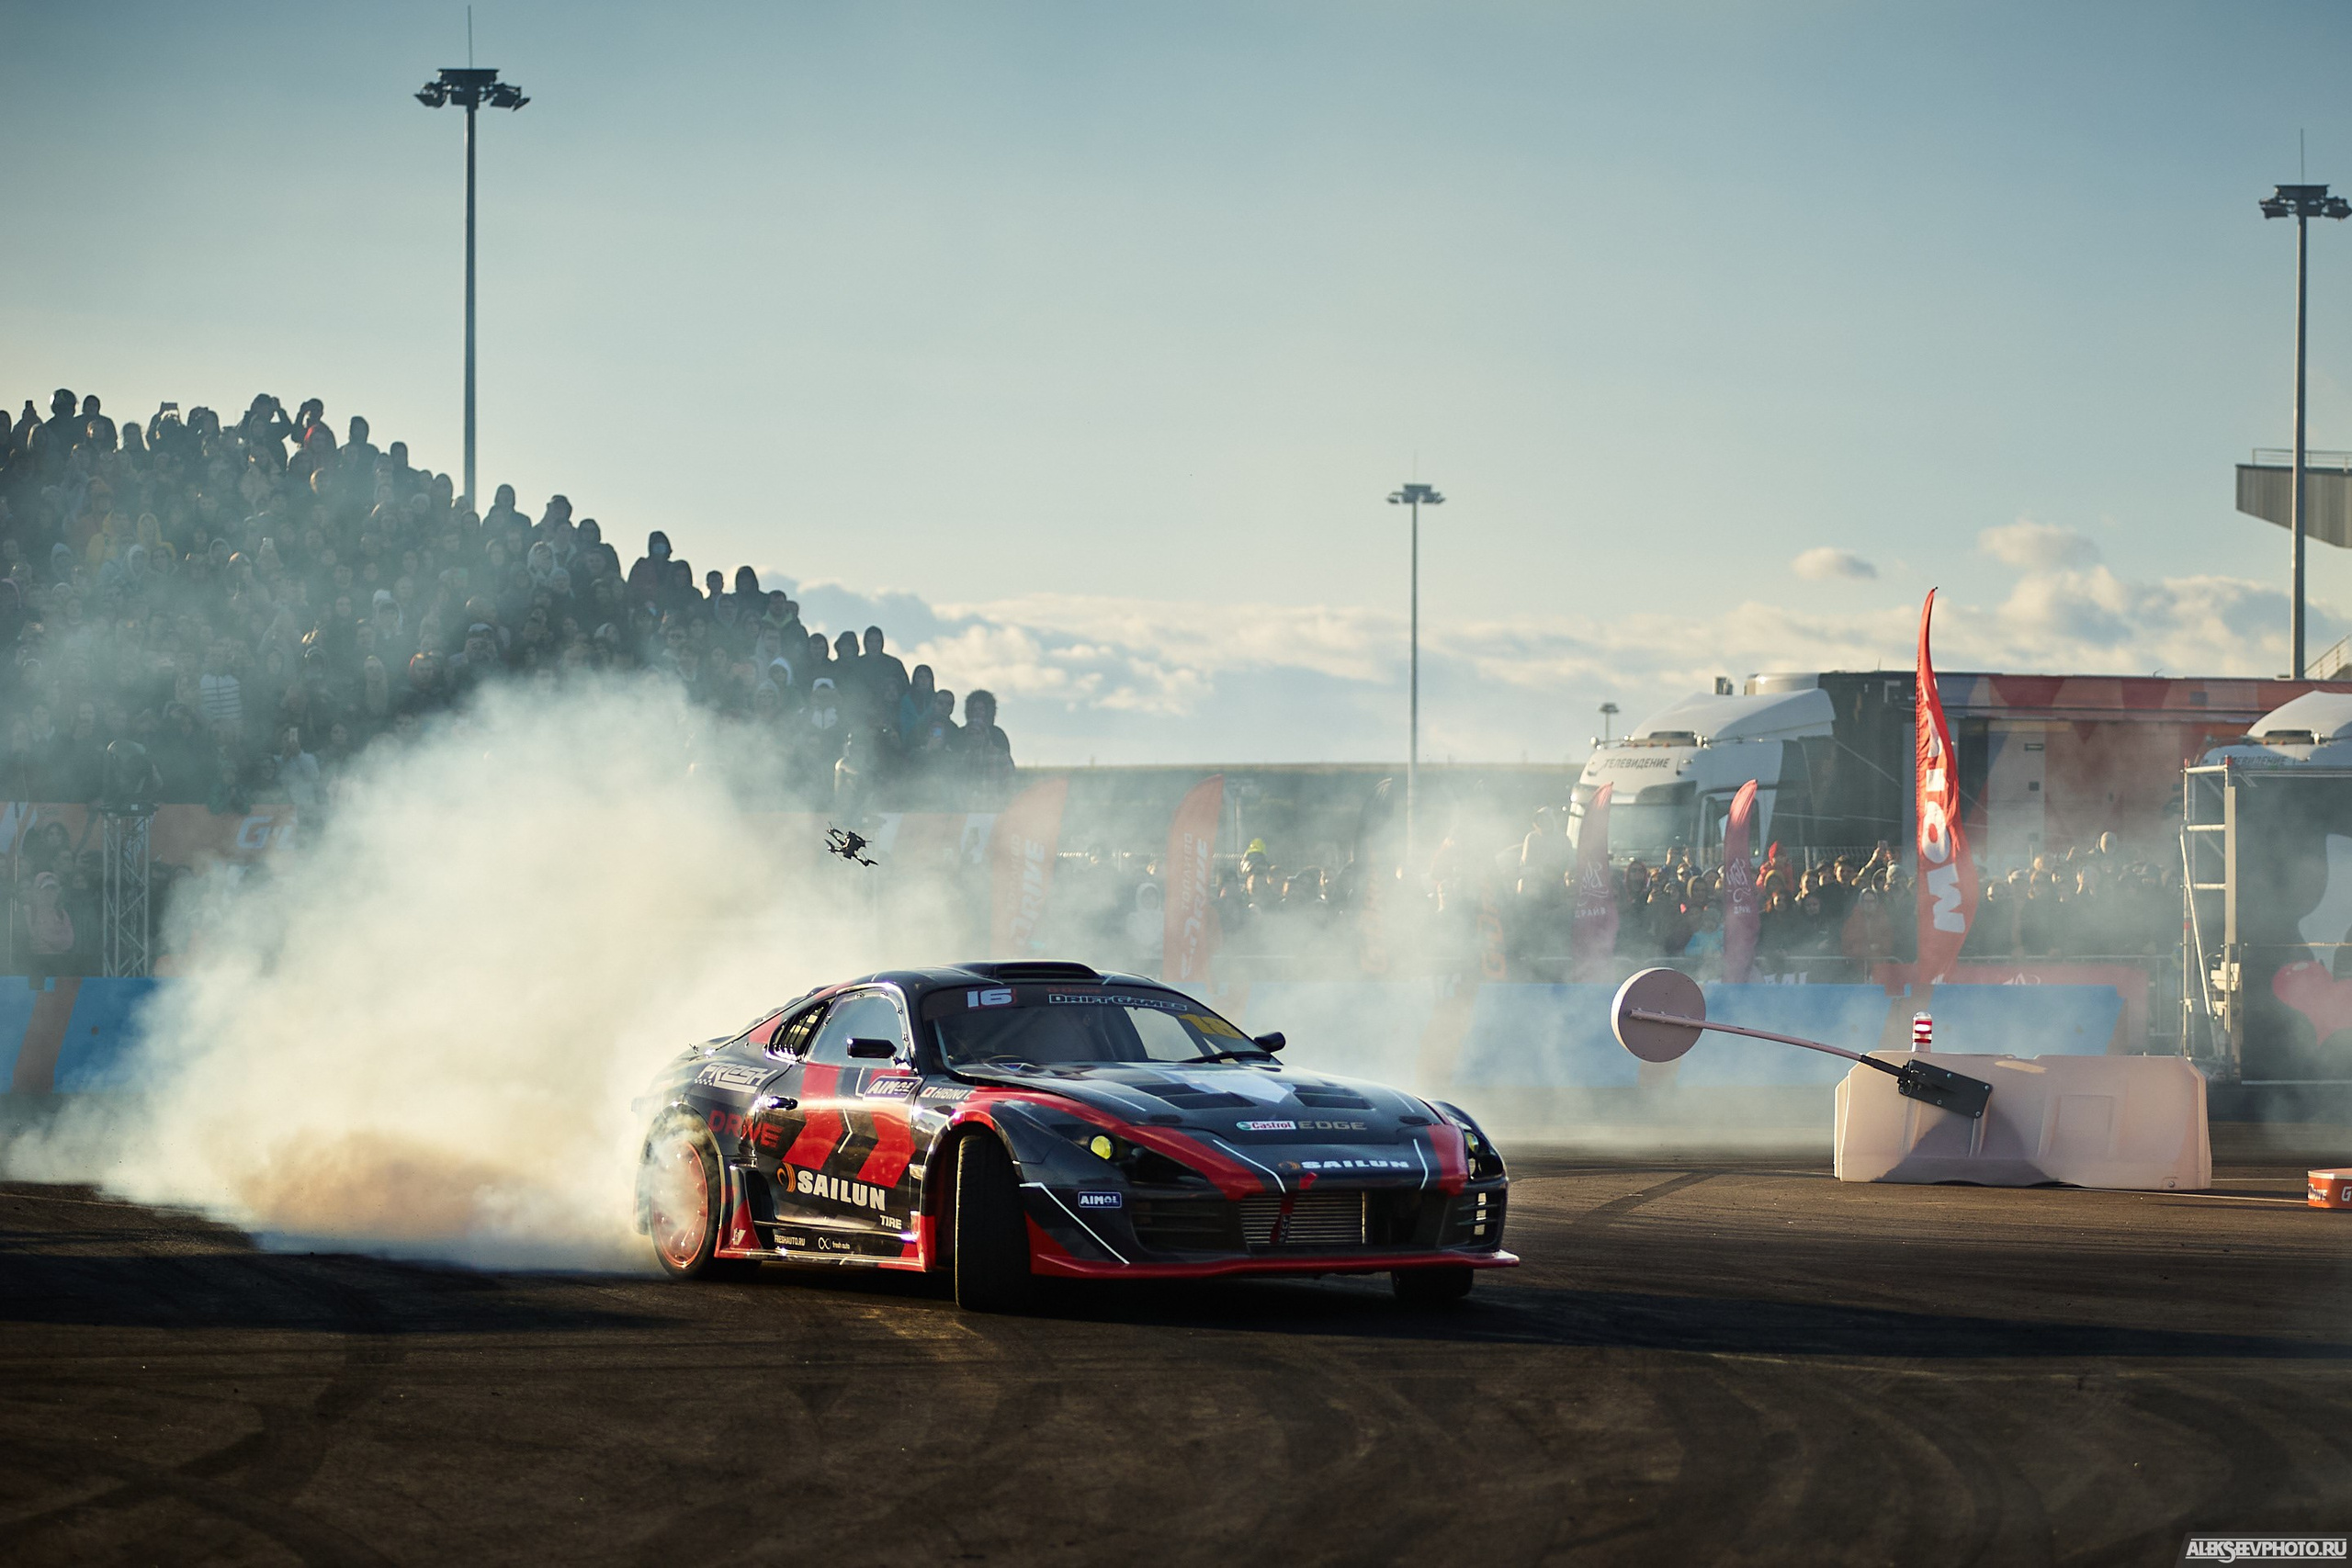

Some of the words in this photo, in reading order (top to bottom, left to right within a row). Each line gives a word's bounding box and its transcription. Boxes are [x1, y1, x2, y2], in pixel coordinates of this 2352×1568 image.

[1603, 758, 1670, 769] ТЕЛЕВИДЕНИЕ
[967, 988, 1012, 1008] 16
[1298, 1121, 1367, 1130] EDGE
[1301, 1159, 1409, 1168] SAILUN
[797, 1170, 886, 1212] SAILUN
[1080, 1195, 1119, 1204] AIMOL
[879, 1214, 902, 1230] TIRE
